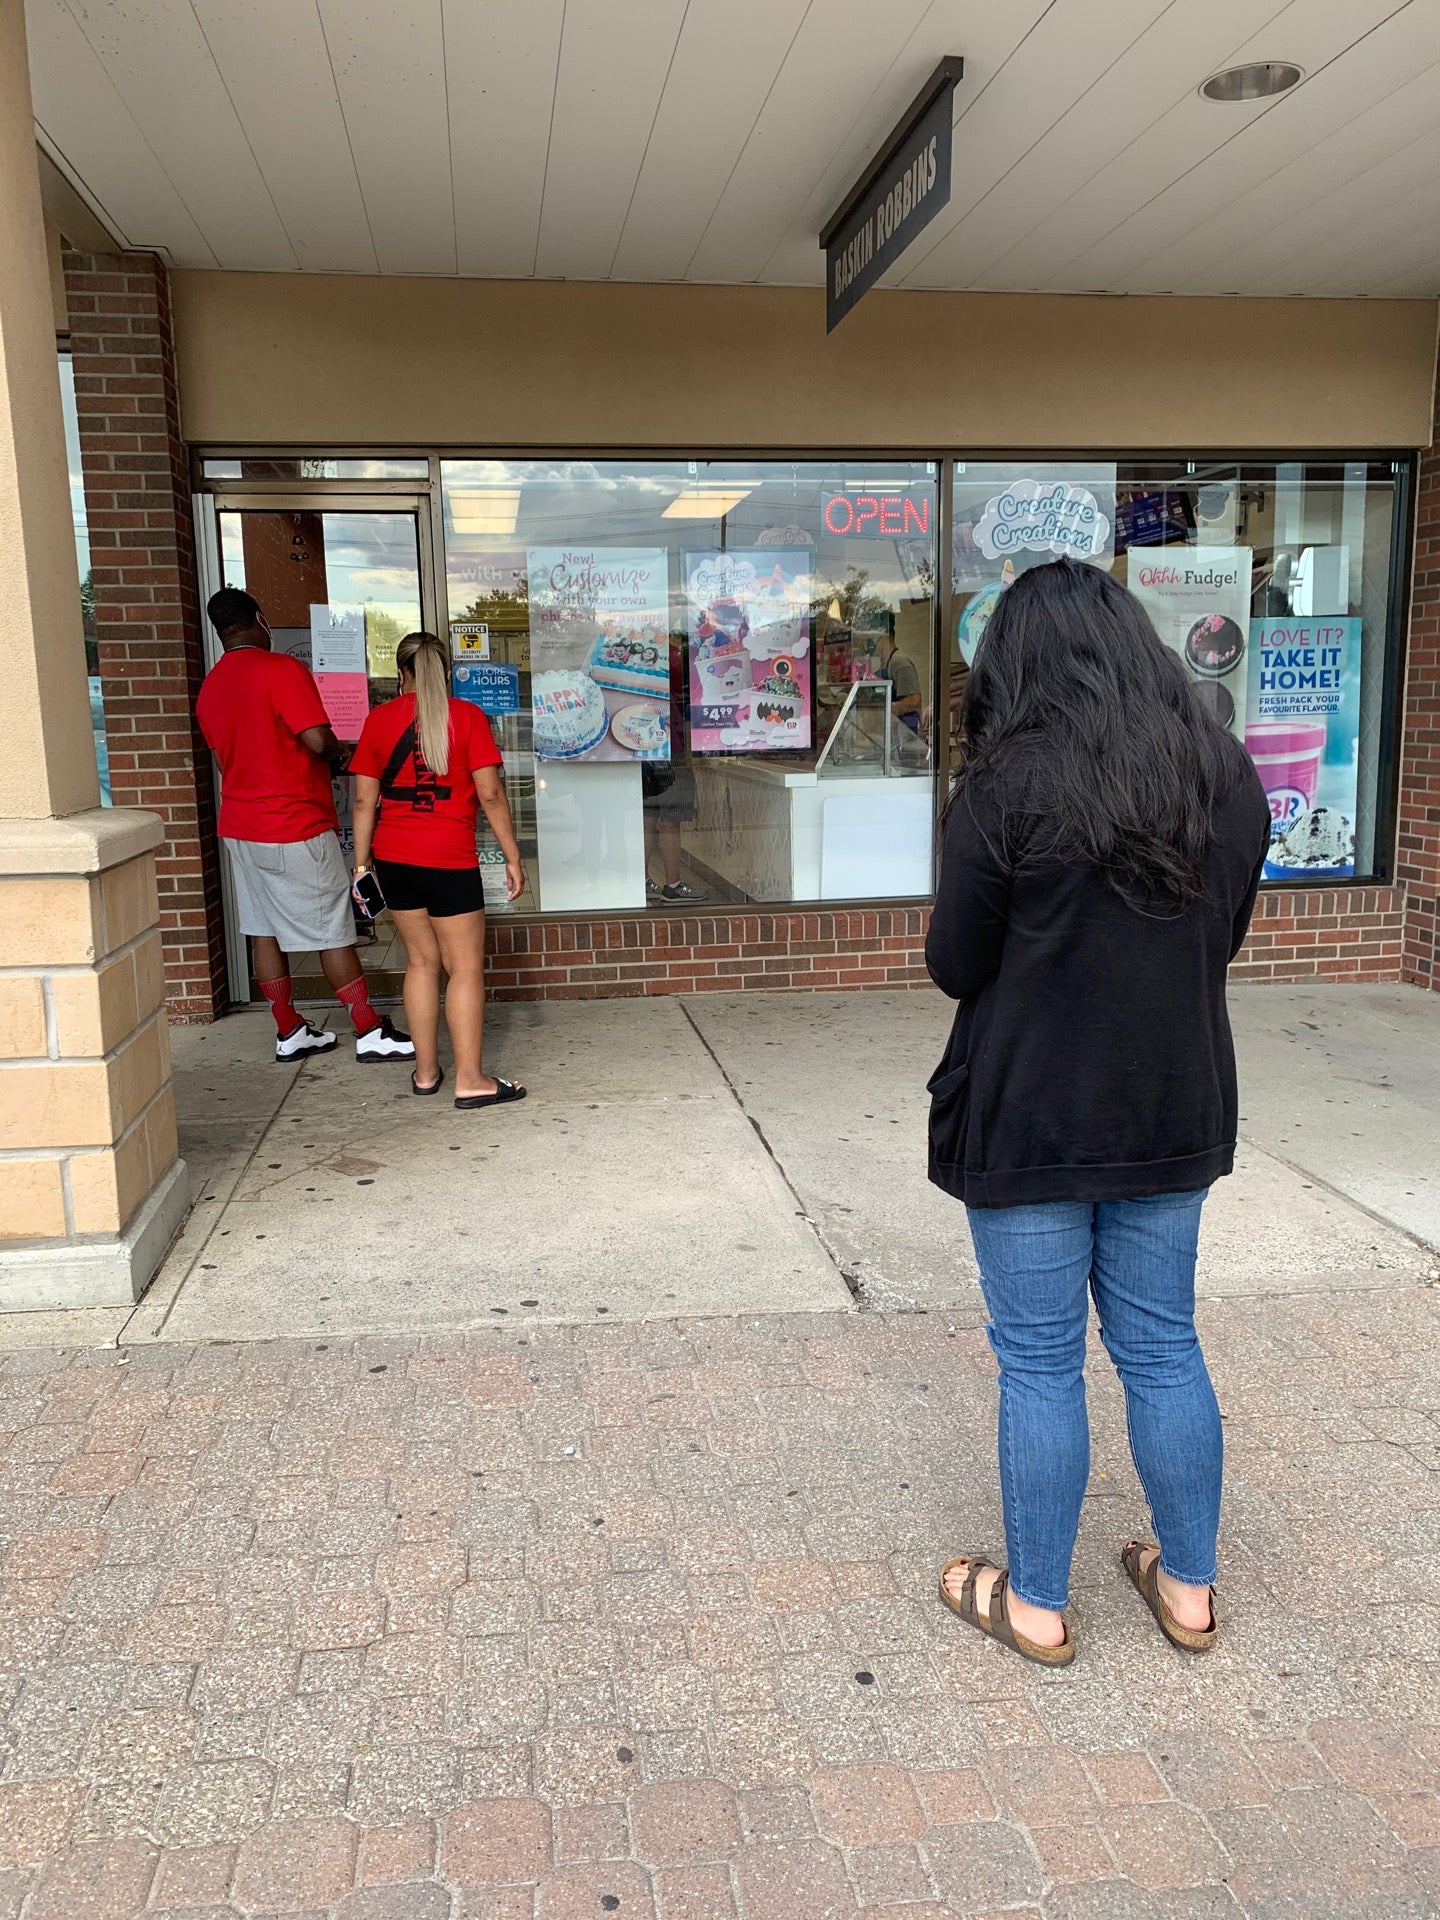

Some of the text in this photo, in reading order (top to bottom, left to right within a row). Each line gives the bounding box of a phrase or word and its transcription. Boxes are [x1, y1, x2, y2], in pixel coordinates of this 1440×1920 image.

[834, 135, 937, 300] BASKIN ROBBINS
[997, 486, 1095, 523] Creature
[825, 496, 929, 535] OPEN
[992, 513, 1093, 551] Creations
[562, 552, 594, 564] New!
[550, 564, 650, 595] Customize
[697, 567, 750, 586] Creature
[1184, 569, 1238, 588] Fudge!
[556, 593, 647, 607] with your own
[541, 611, 584, 624] phos
[1260, 628, 1344, 647] LOVE IT?
[1260, 648, 1342, 668] TAKE IT
[472, 676, 510, 685] HOURS
[476, 667, 506, 676] STORE
[1260, 669, 1340, 690] HOME!
[534, 688, 580, 706] HAPPY
[1260, 697, 1287, 705] FRESH
[1290, 696, 1312, 704] PACK
[535, 698, 587, 716] BIRTHDAY
[1259, 704, 1339, 713] FAVOURITE FLAVOUR.
[478, 850, 505, 865] ASS
